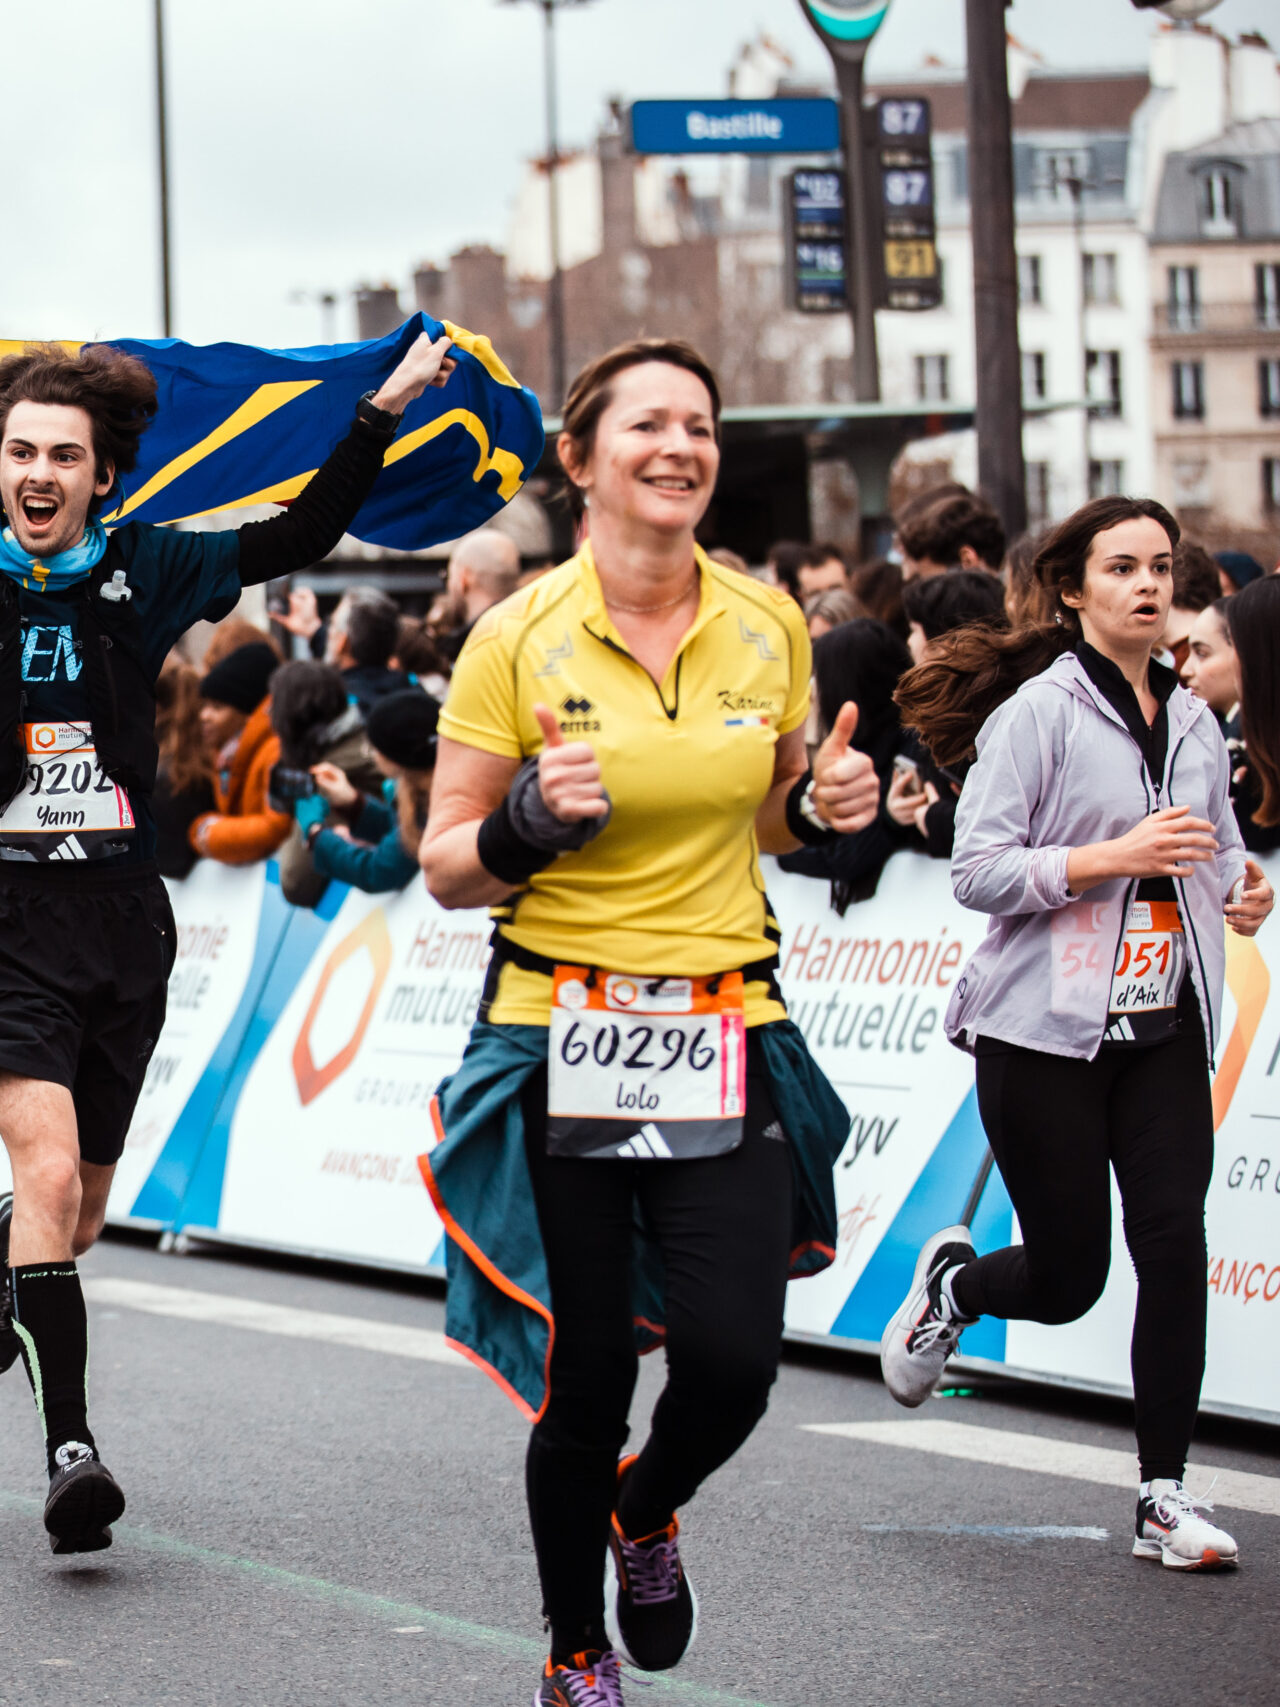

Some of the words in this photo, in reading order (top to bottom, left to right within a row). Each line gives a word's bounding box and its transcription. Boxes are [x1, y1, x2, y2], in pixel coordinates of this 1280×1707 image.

[686, 110, 783, 139] Bastille
[882, 101, 923, 135] 87
[886, 171, 926, 205] 87
[36, 805, 85, 828] Yann
[781, 923, 963, 988] Harmonie
[787, 990, 938, 1054] utuelle
[560, 1021, 717, 1072] 60296
